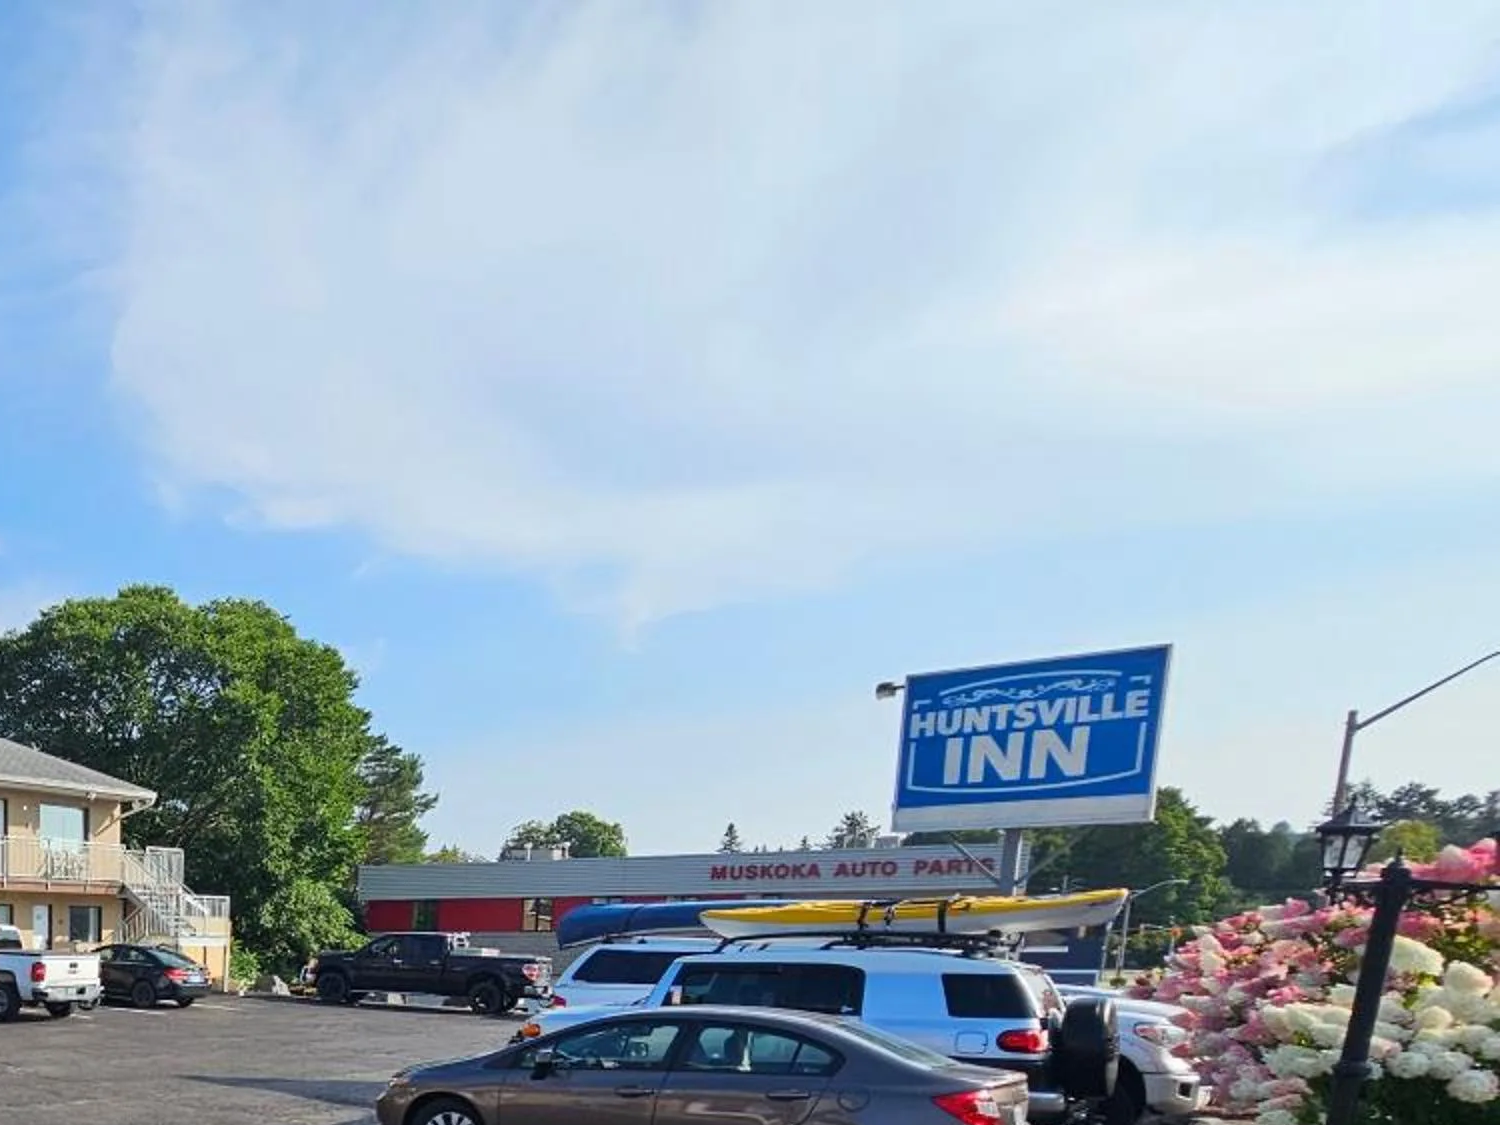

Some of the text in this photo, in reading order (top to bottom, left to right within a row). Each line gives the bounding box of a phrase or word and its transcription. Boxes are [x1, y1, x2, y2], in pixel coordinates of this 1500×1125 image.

[910, 689, 1149, 738] HUNTSVILLE
[943, 725, 1091, 785] INN
[710, 857, 996, 881] MUSKOKA AUTO PARTS
